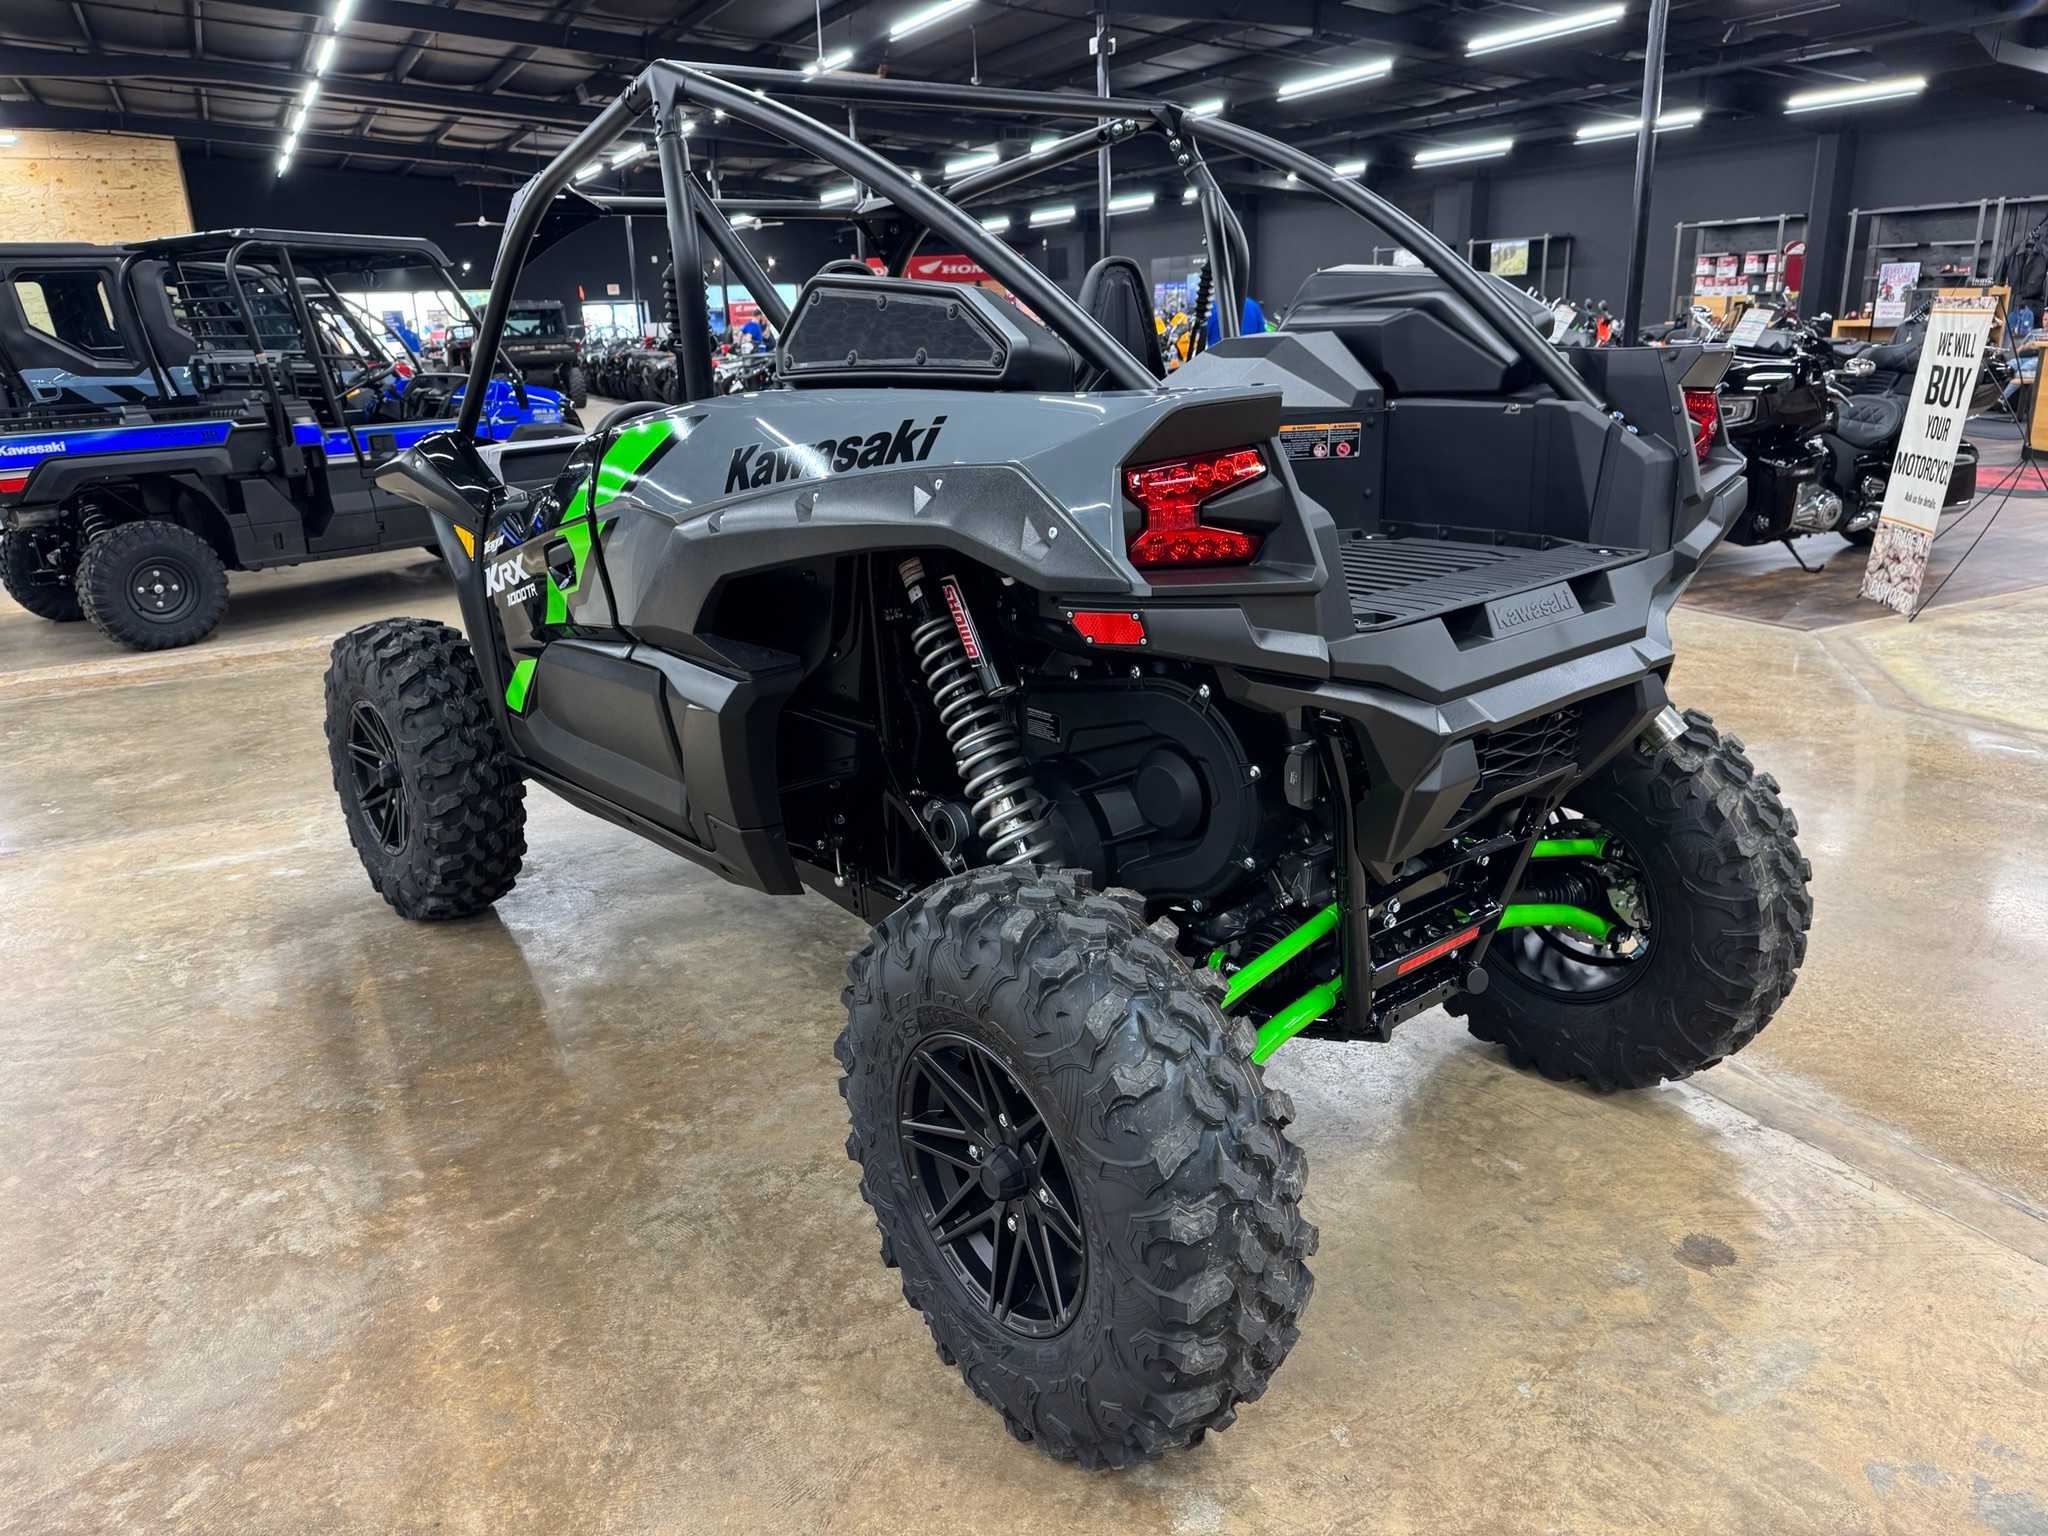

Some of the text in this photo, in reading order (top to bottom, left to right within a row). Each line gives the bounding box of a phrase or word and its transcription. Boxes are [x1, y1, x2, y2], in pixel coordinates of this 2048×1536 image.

[941, 264, 986, 274] HON
[1937, 332, 1977, 358] WE WILL
[1924, 364, 1973, 409] BUY
[1925, 414, 1951, 442] YOUR
[0, 441, 66, 456] Kawasaki
[724, 415, 948, 494] Kawasaki
[1893, 451, 1954, 486] MOTORCYCL
[484, 553, 531, 598] KRX
[507, 582, 538, 607] 1000TR
[1492, 589, 1574, 630] Kawasaki
[943, 584, 980, 659] SHOWA
